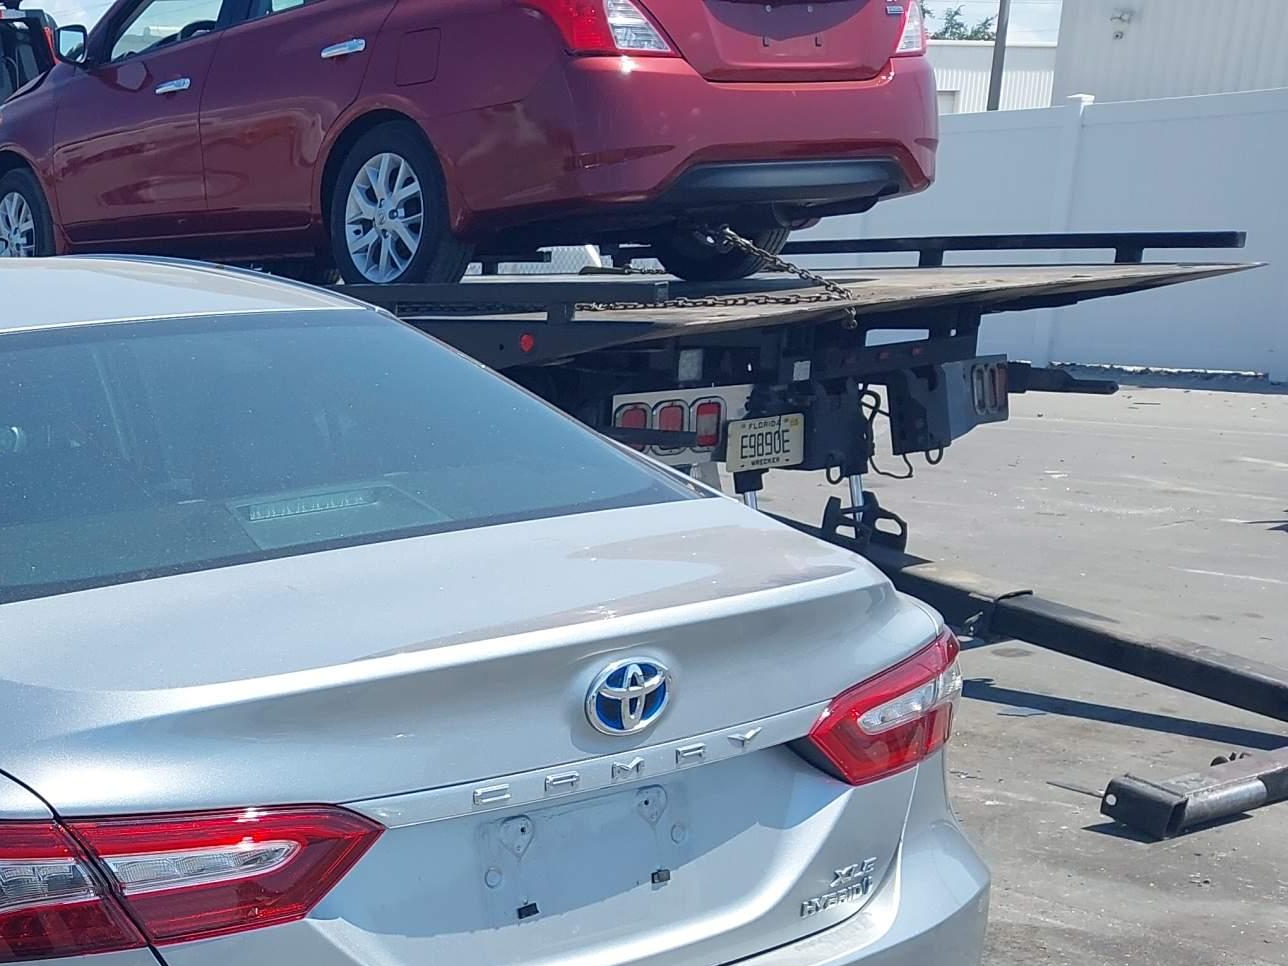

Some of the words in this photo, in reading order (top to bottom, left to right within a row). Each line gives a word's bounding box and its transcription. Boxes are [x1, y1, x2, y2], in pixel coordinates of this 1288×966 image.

[748, 419, 782, 430] FLORIDA
[740, 429, 791, 459] E9890E
[751, 456, 781, 466] WRECKER
[473, 727, 762, 805] CAMRY
[830, 856, 877, 888] XLE
[799, 881, 863, 919] HYBRID
